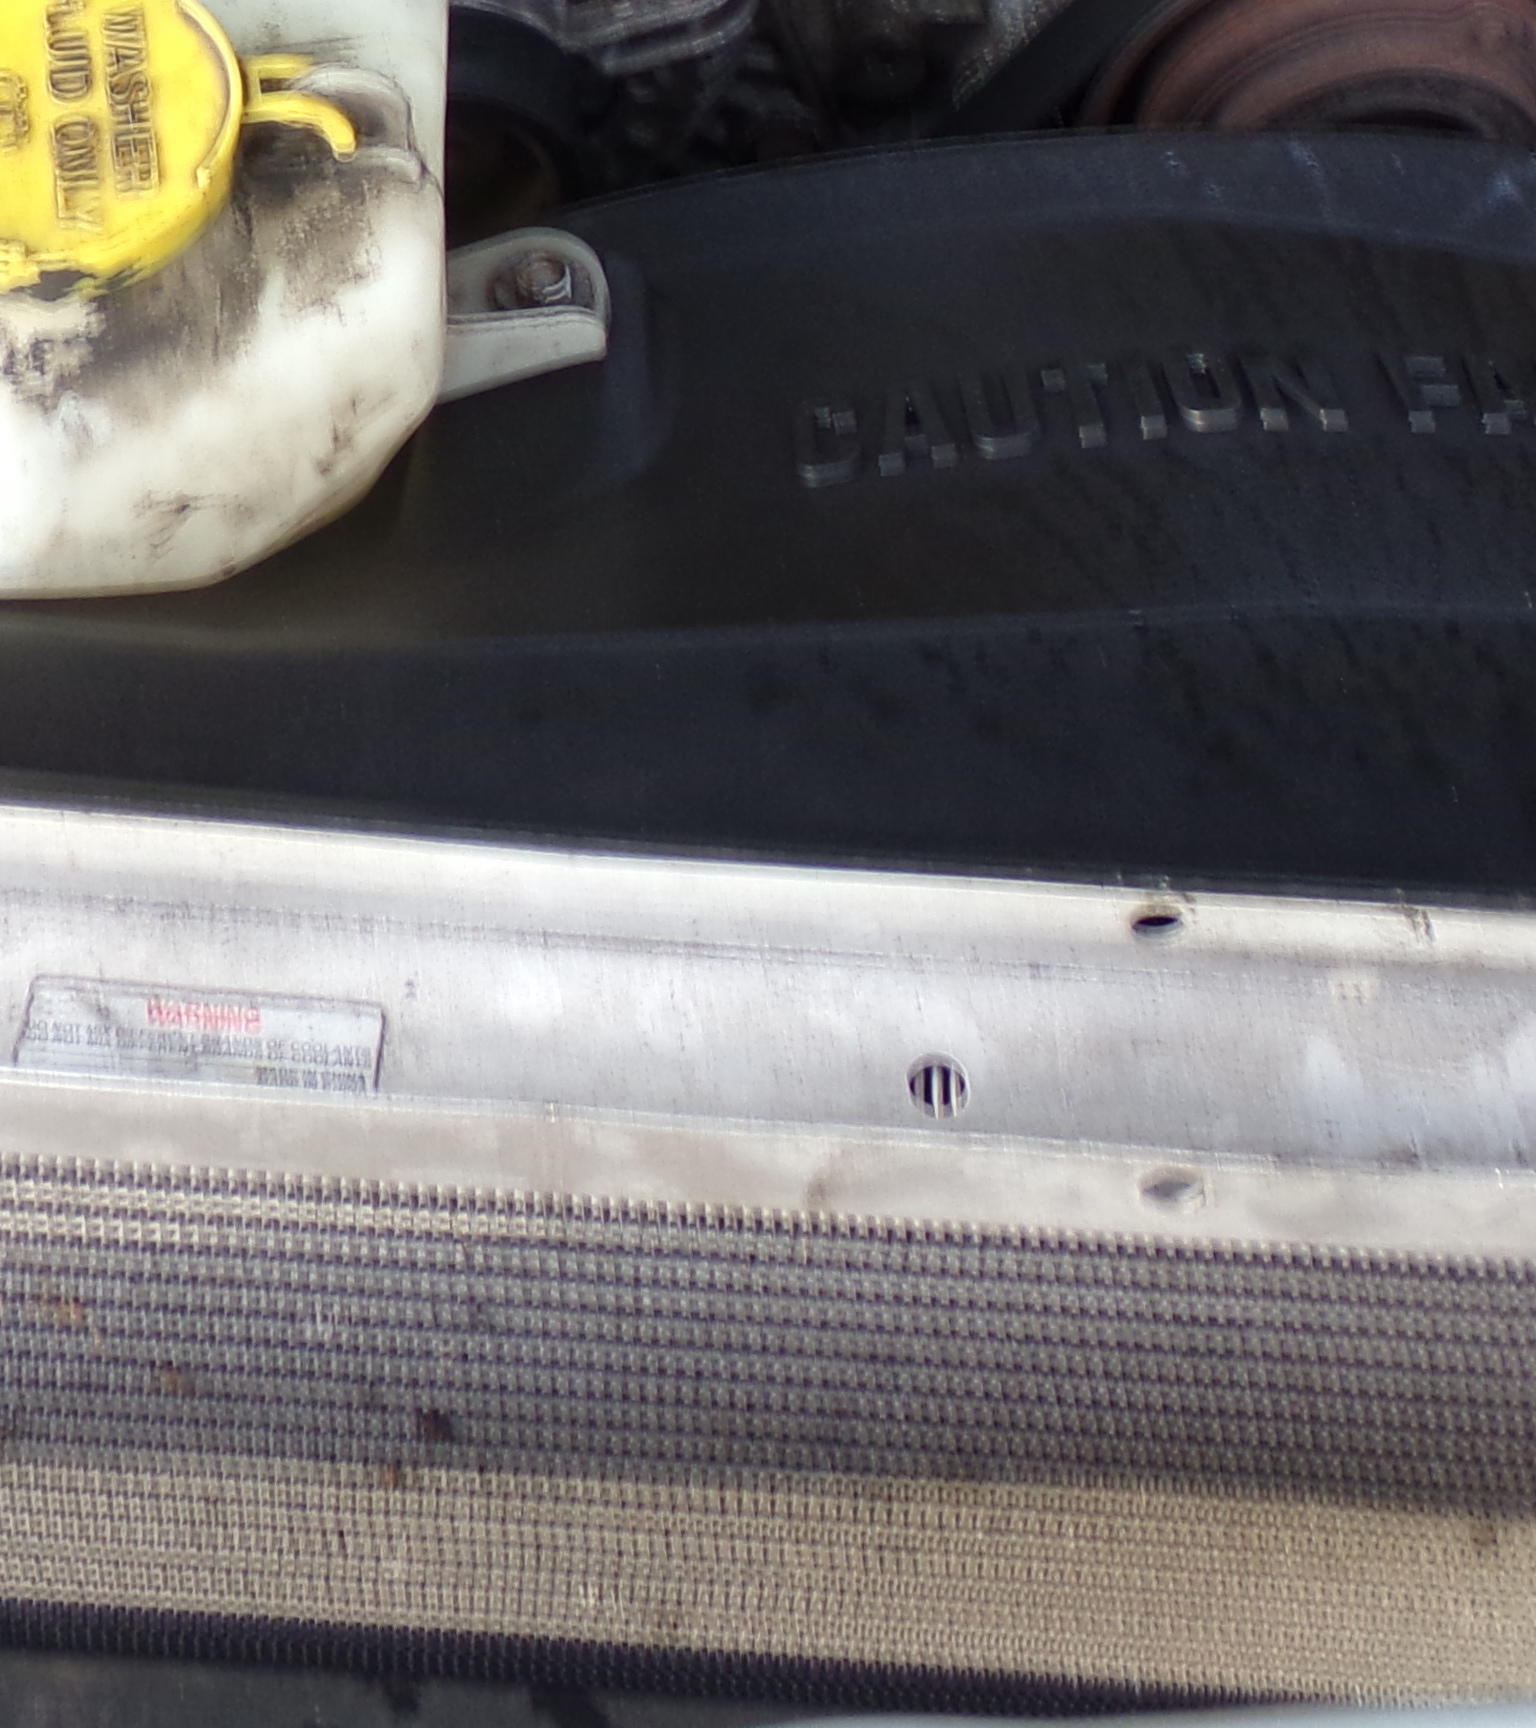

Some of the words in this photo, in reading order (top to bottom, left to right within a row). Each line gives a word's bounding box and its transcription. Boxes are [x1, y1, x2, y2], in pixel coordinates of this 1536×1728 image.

[102, 4, 161, 193] WASHER
[52, 115, 102, 232] ONLY
[795, 352, 1350, 489] CAUTION
[146, 997, 261, 1035] WARNING
[267, 1038, 285, 1061] OF
